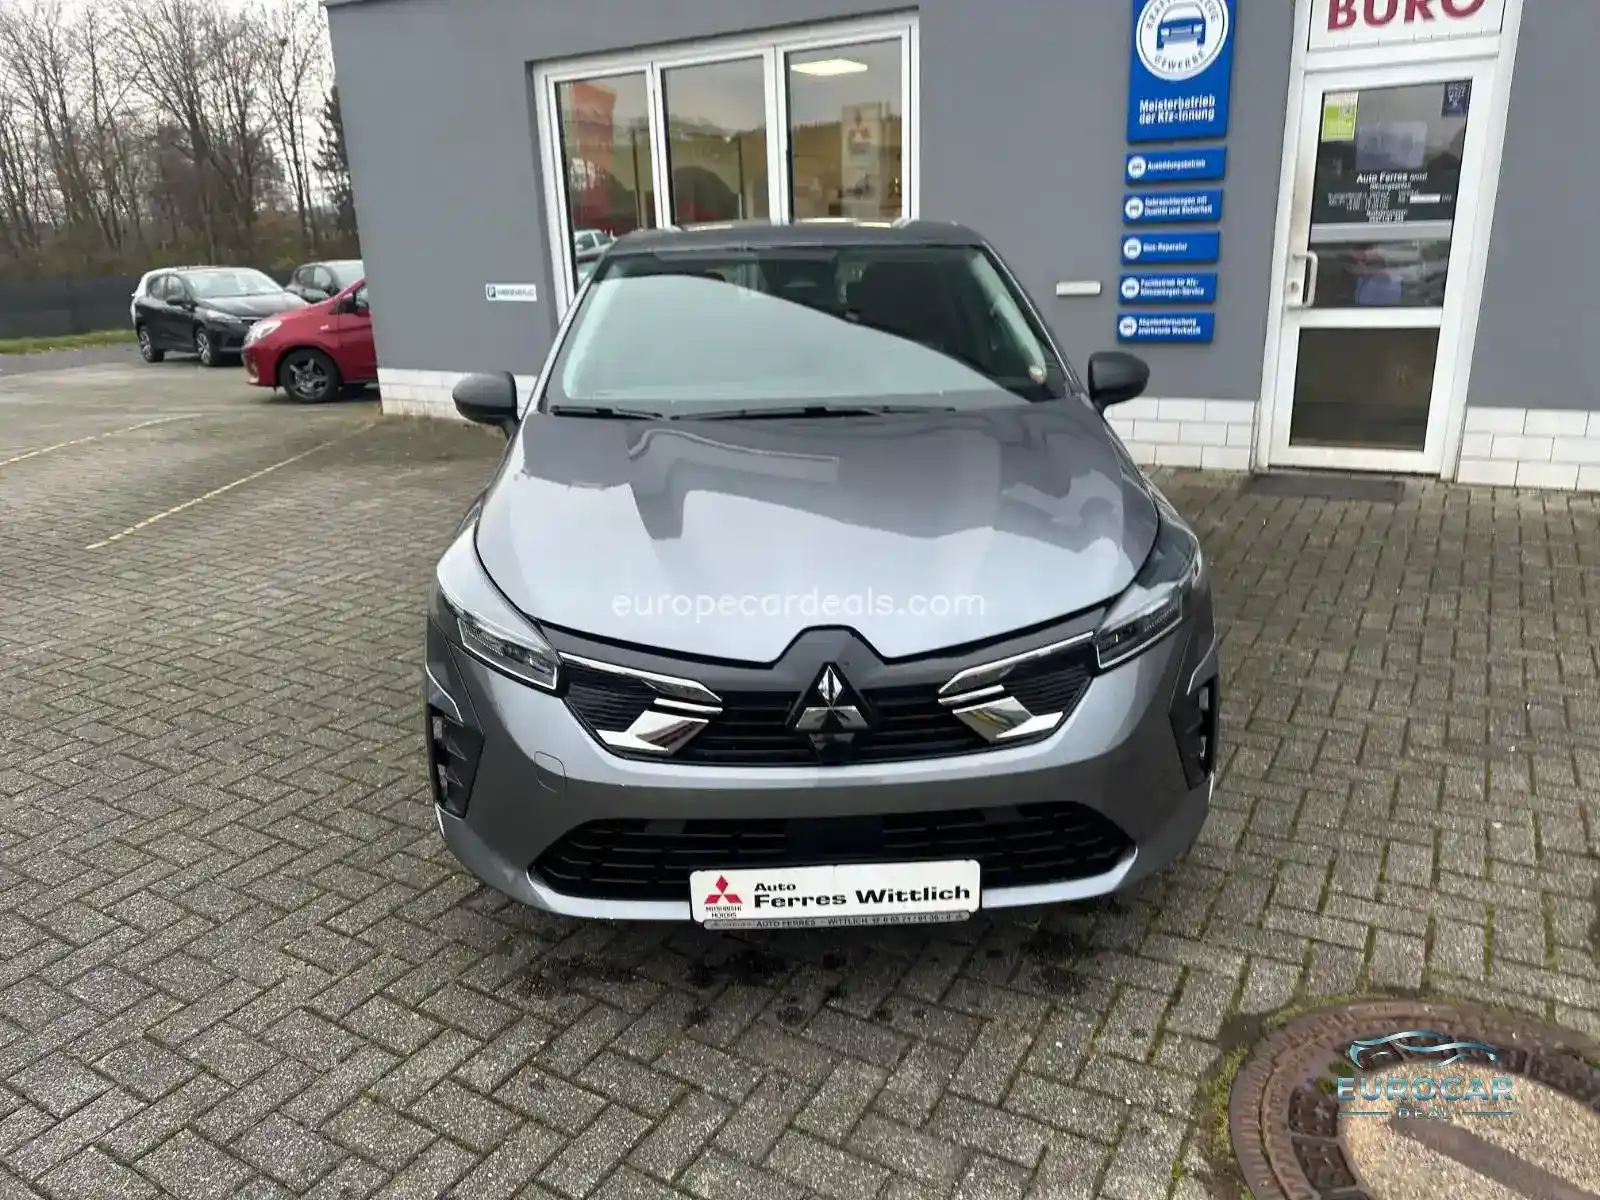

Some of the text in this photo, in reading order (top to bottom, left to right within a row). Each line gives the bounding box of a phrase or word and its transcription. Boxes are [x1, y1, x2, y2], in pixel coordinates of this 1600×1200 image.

[1140, 93, 1215, 113] Meisterbetrieb
[1139, 106, 1215, 125] der Kfz-Innung
[1356, 173, 1378, 184] Auto
[1379, 171, 1408, 182] Ferres
[754, 882, 796, 892] Auto
[754, 885, 970, 909] Ferres Wittlich
[757, 920, 778, 928] AUTO
[780, 919, 816, 927] FERRES
[827, 917, 868, 926] WITTLICH
